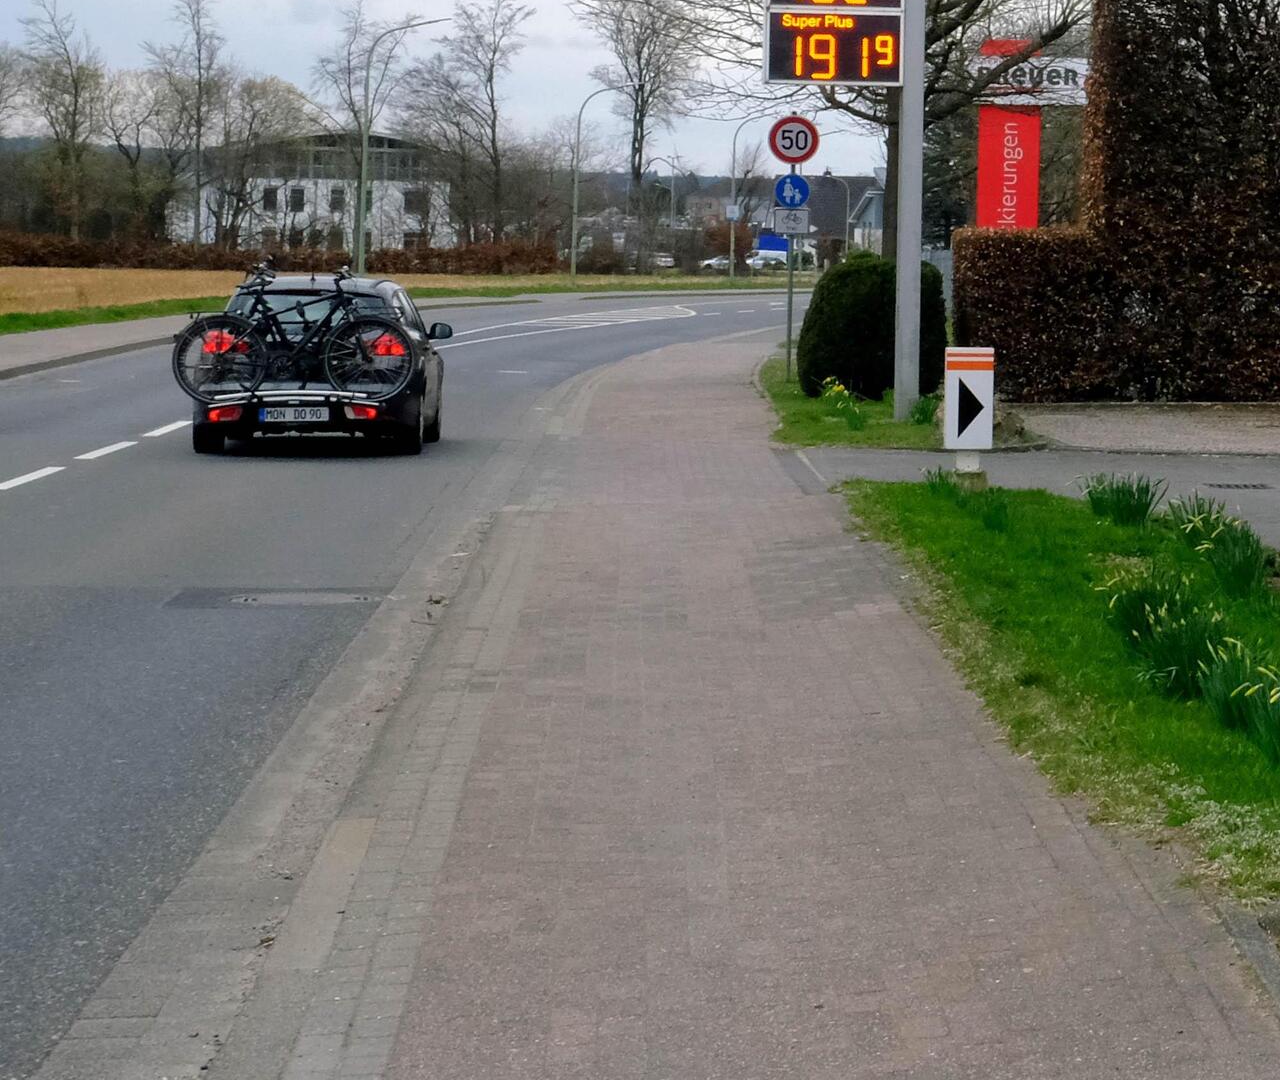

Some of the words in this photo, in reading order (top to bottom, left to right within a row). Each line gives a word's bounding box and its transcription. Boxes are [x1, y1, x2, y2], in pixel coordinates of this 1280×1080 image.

[782, 14, 822, 29] Super
[825, 15, 854, 29] Plus
[781, 129, 808, 150] 50
[998, 122, 1023, 228] kierungen
[266, 409, 286, 420] MON
[309, 409, 322, 419] 90
